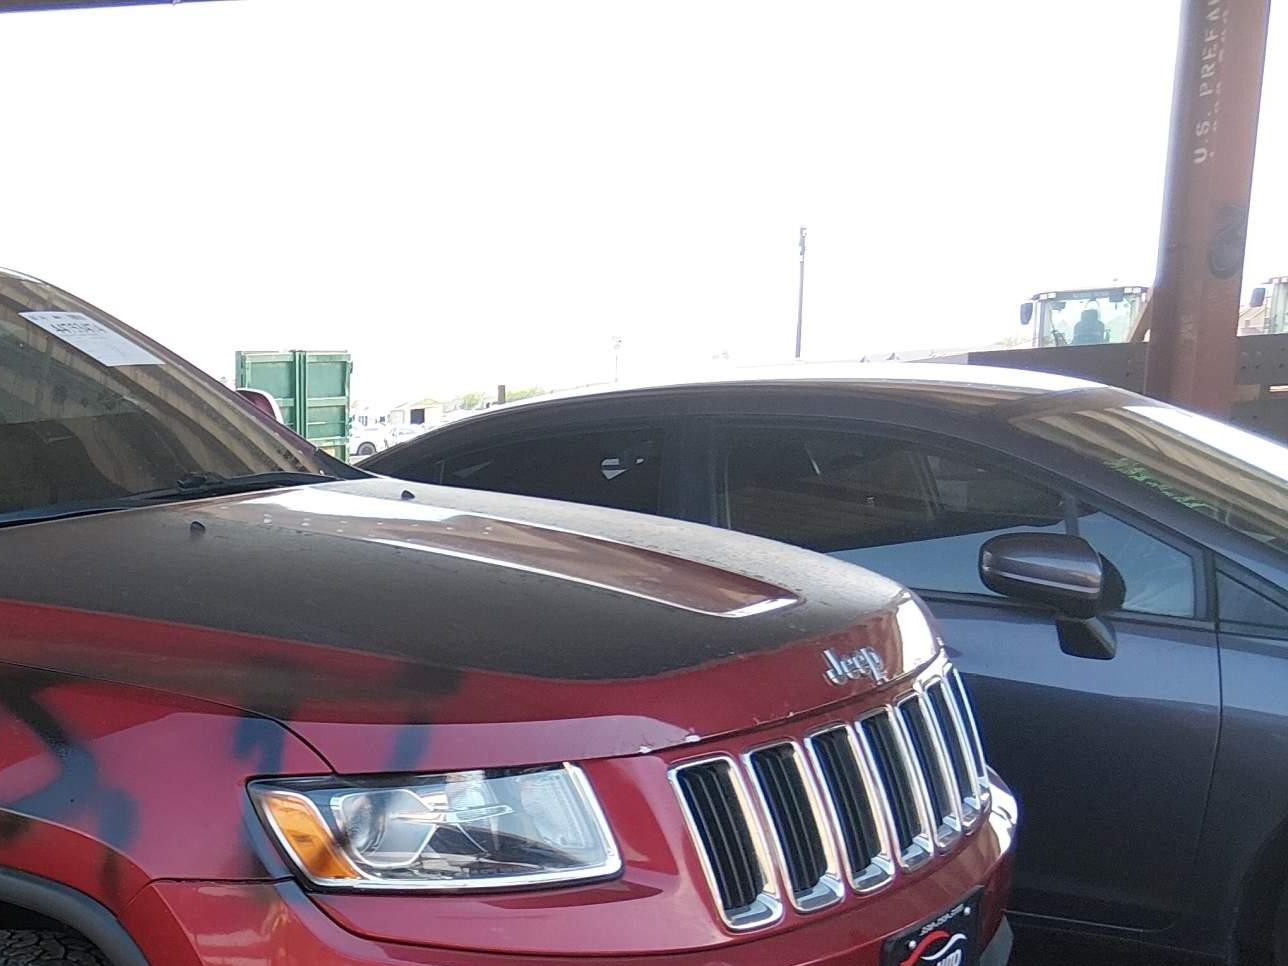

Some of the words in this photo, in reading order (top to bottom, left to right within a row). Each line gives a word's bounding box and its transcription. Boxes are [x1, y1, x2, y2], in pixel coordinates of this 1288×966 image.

[1200, 0, 1222, 97] PREFA
[1192, 112, 1211, 164] U.S.
[821, 646, 886, 686] Jeep
